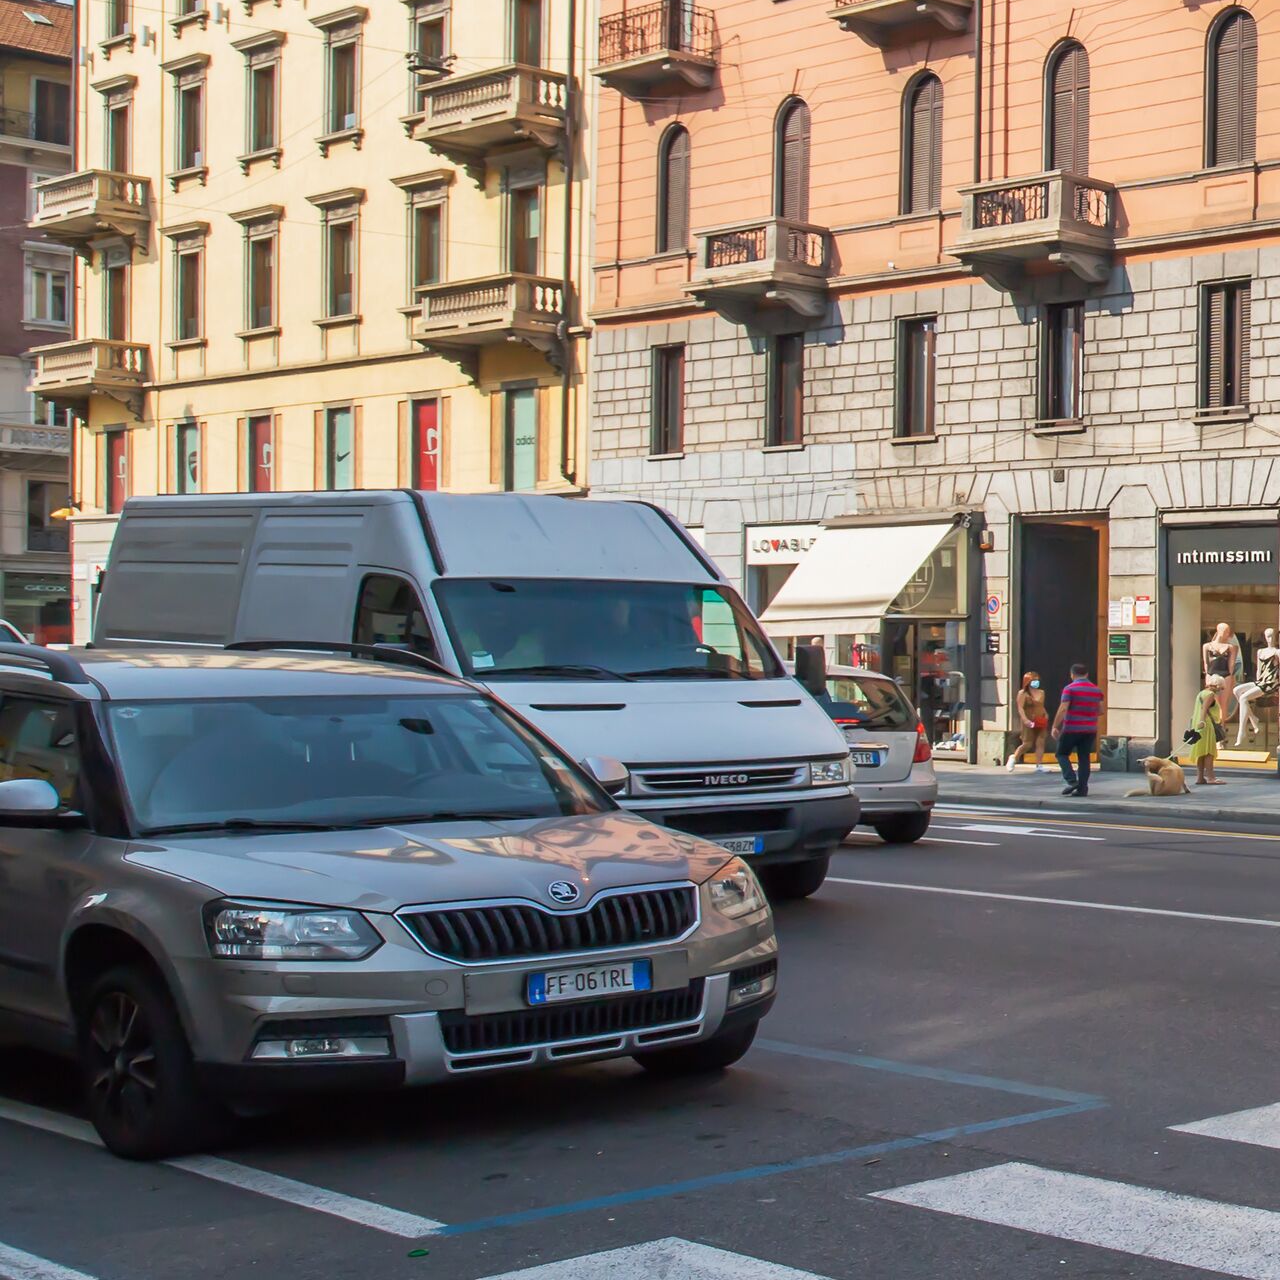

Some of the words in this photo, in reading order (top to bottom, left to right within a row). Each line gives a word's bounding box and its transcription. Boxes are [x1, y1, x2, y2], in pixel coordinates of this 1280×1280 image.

[1177, 549, 1272, 564] intimissimi
[24, 584, 67, 592] GEOX
[704, 774, 748, 785] IVECO
